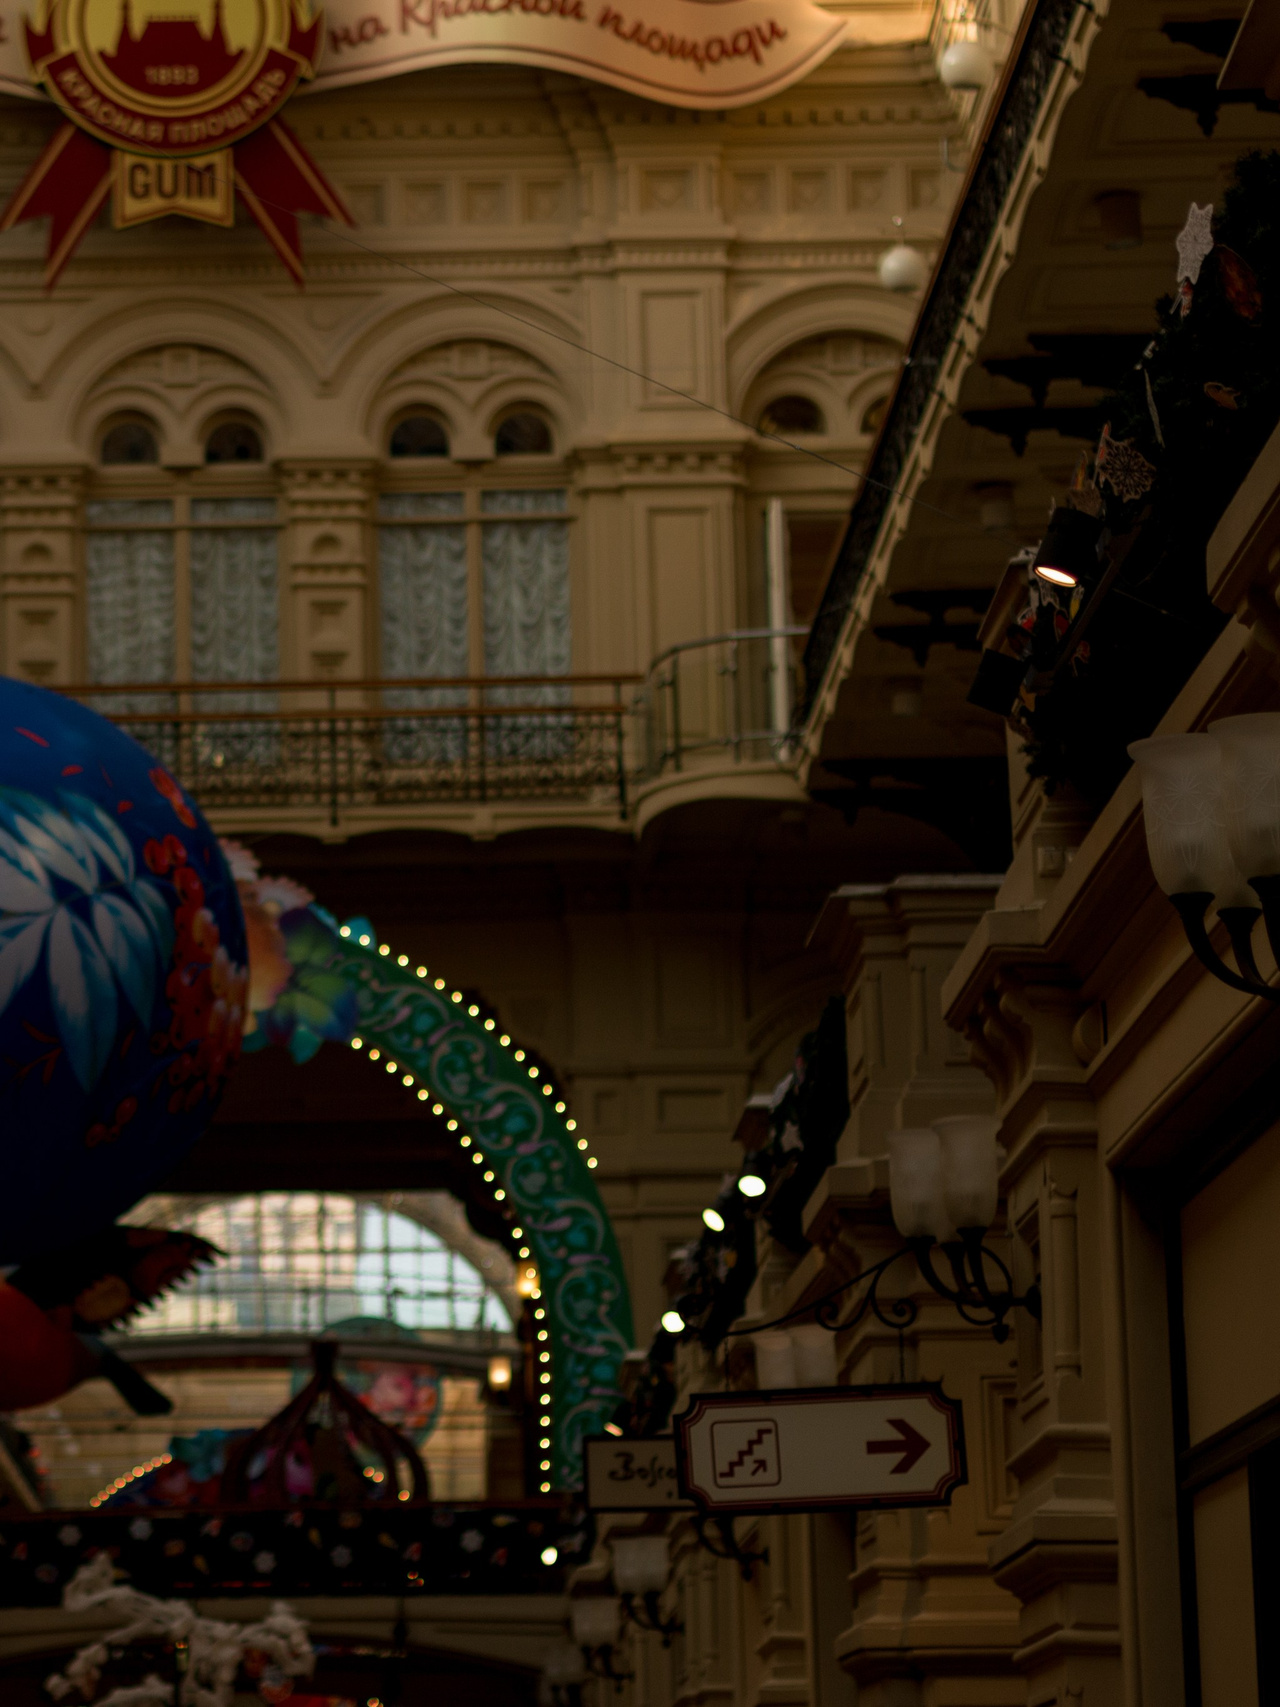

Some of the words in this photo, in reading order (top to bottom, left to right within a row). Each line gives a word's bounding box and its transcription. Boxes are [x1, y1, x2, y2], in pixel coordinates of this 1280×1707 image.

[329, 16, 387, 53] на
[599, 7, 787, 73] площади
[57, 66, 166, 143] КРАСНАЯ
[167, 67, 287, 144] ПЛОЩАДЬ
[130, 162, 215, 200] GUM
